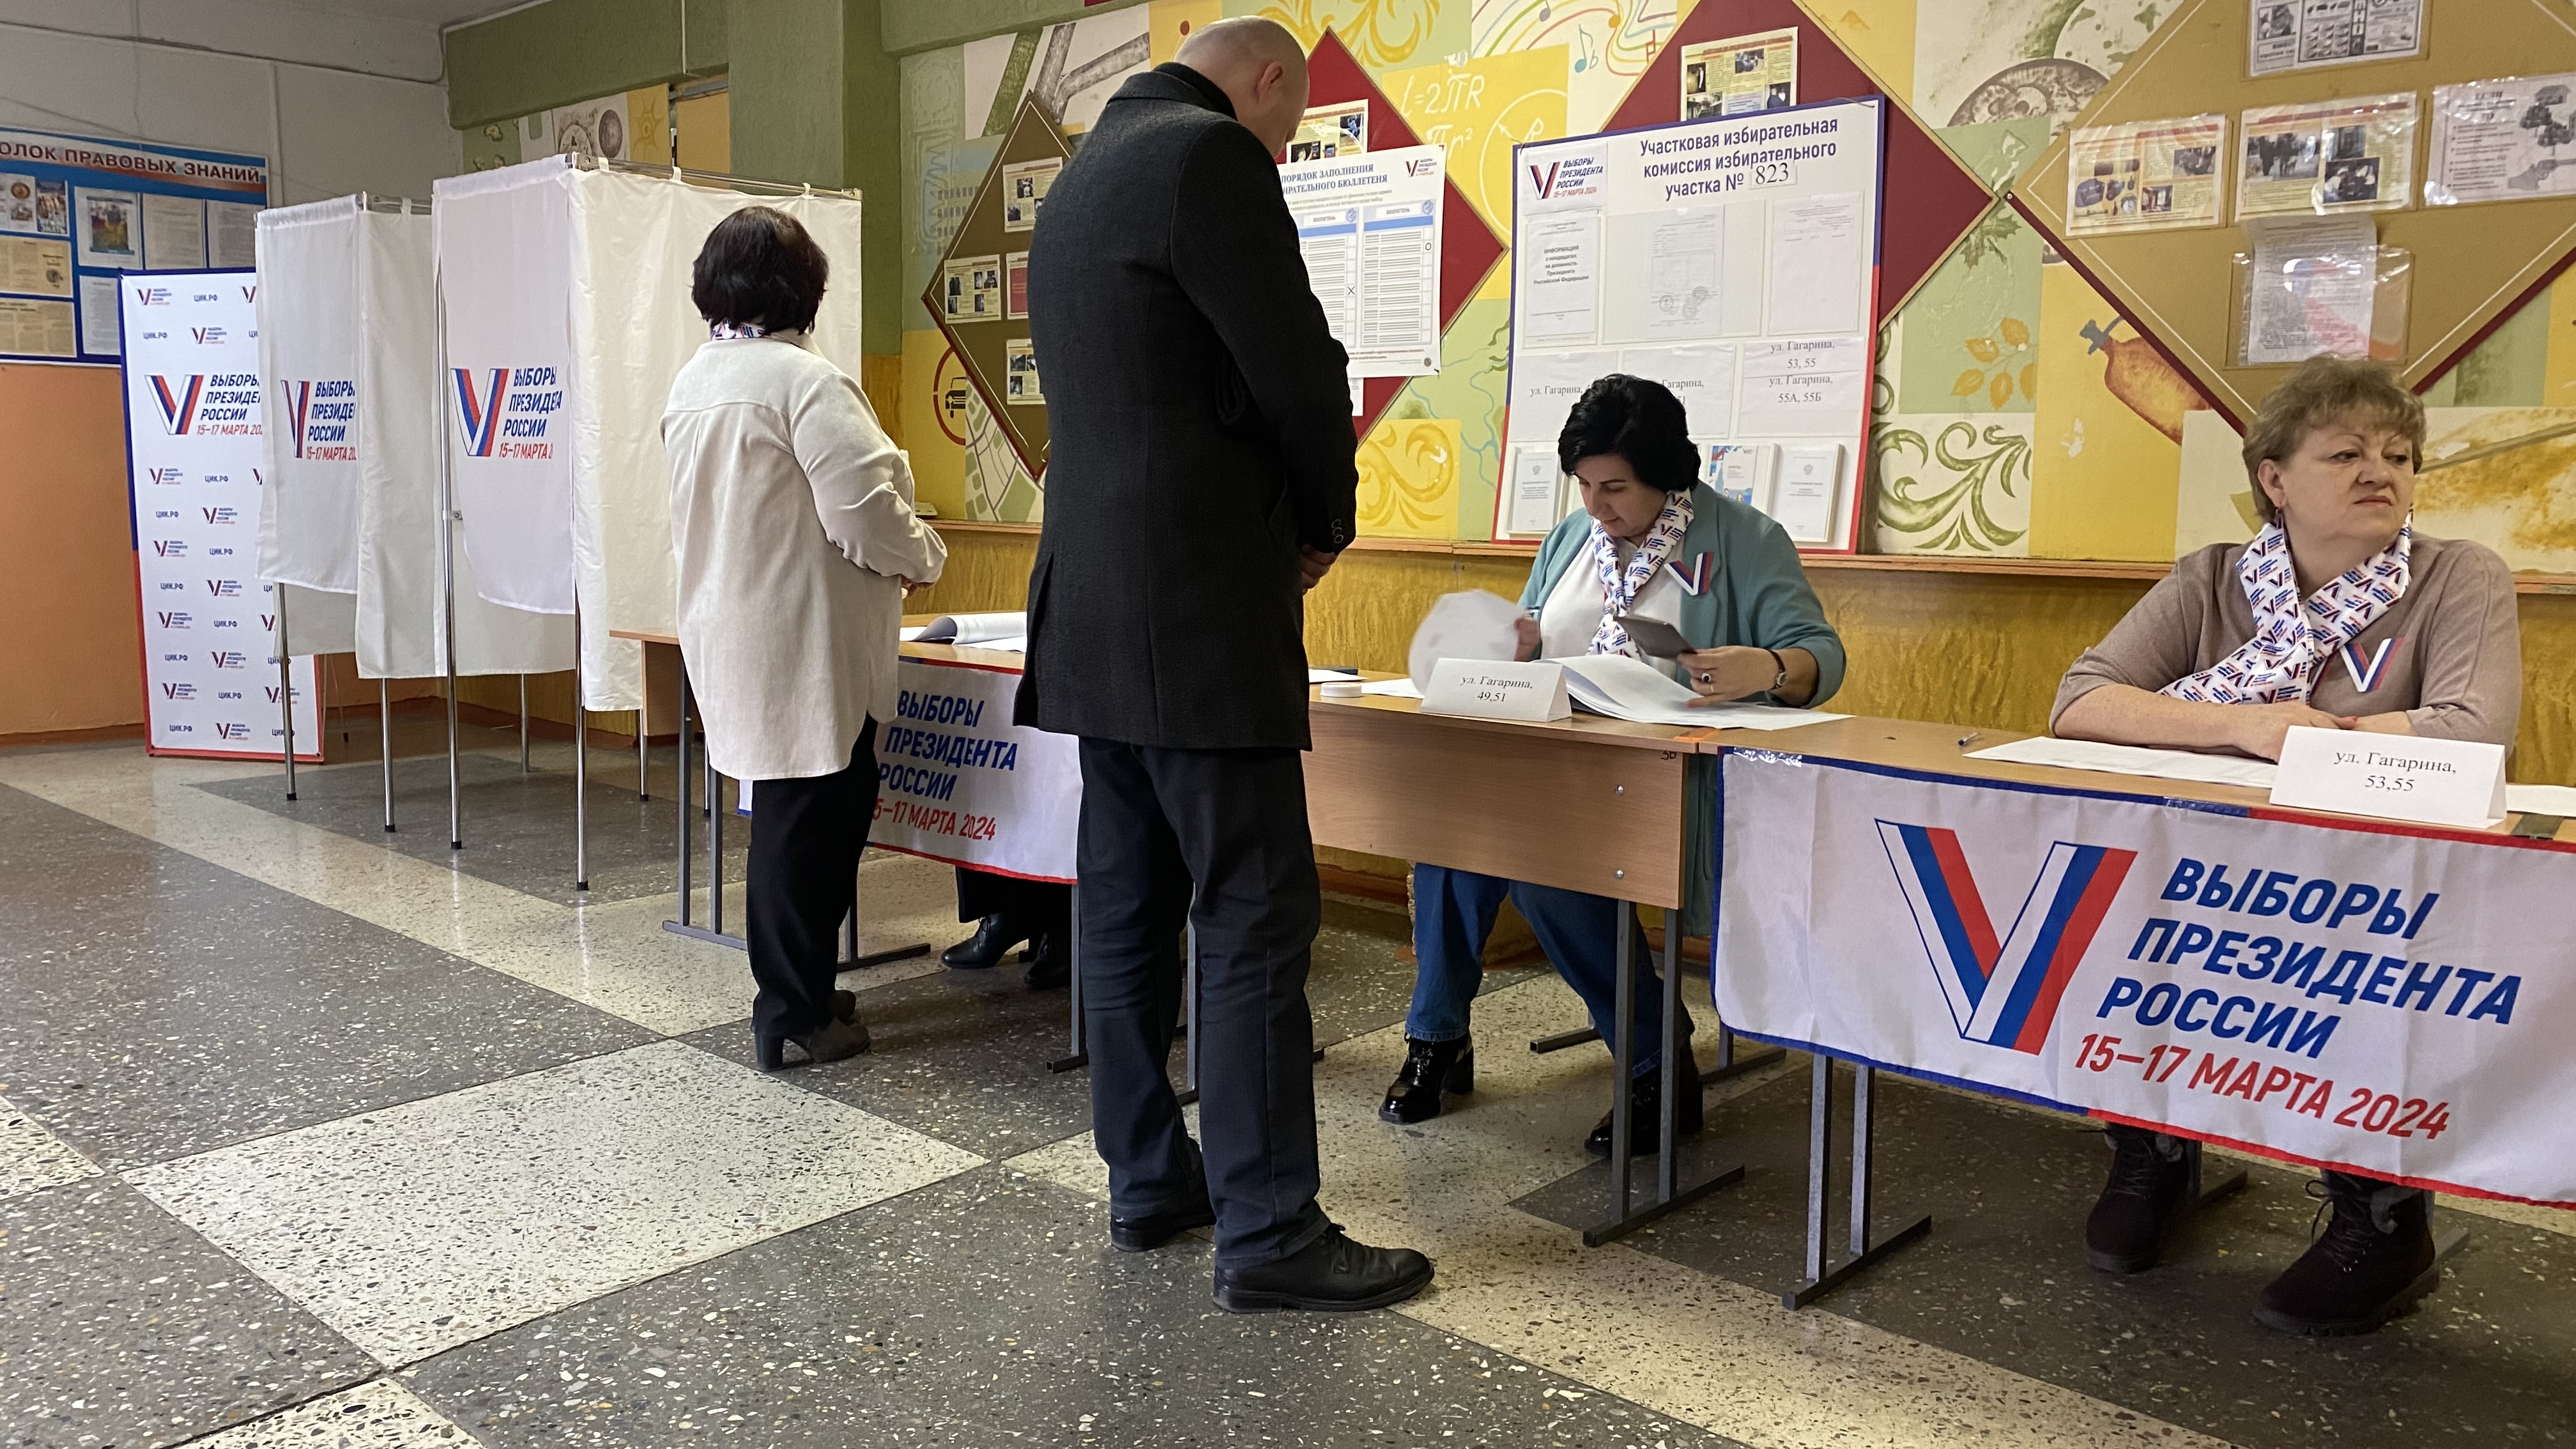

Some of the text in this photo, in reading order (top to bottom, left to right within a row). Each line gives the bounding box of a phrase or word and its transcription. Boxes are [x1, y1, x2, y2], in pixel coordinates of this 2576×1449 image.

[1640, 119, 1838, 157] Участковая избирательная
[65, 148, 177, 174] ПРАВОВЫХ
[184, 162, 260, 183] ЗНАНИЙ
[1563, 157, 1594, 168] ВЫБОРЫ
[1644, 142, 1837, 178] комиссия избирательного
[1281, 164, 1374, 183] ПОРЯДОК ЗАПОЛНЕНИЯ
[1338, 174, 1388, 188] БЮЛЛЕТЕНЯ
[1560, 166, 1604, 179] ПРЕЗИДЕНТА
[1666, 162, 1789, 201] участка № 823
[1556, 179, 1584, 189] РОССИИ
[1770, 341, 1835, 354] ул. Гагарина,
[1787, 358, 1816, 369] 53, 55
[514, 366, 556, 387] ВЫБОРЫ
[1769, 375, 1833, 388] ул. Гагарина,
[1530, 385, 1583, 397] ул. Гагарина,
[1778, 392, 1821, 403] 55А, 55Б
[201, 408, 247, 420] РОССИИ
[220, 424, 249, 435] МАРТА
[308, 425, 346, 441] РОССИИ
[503, 419, 547, 437] РОССИИ
[323, 447, 347, 461] МАРТА
[521, 443, 548, 459] МАРТА
[1460, 676, 1533, 689] ул. Гагарина,
[1477, 691, 1506, 703] 49,51
[897, 690, 985, 728] ВЫБОРЫ
[884, 726, 1018, 770] ПРЕЗИДЕНТА
[2334, 752, 2457, 775] ул. Гагарина,
[879, 763, 957, 801] РОССИИ
[2365, 774, 2415, 792] 53,55
[907, 804, 957, 836] МАРТА
[958, 813, 997, 841] 2024
[2160, 857, 2439, 939] ВЫБОРЫ
[2128, 917, 2522, 1025] ПРЕЗИДЕНТА
[2096, 977, 2341, 1059] РОССИИ
[2188, 1052, 2334, 1119] МАРТА
[2334, 1087, 2450, 1140] 2024
